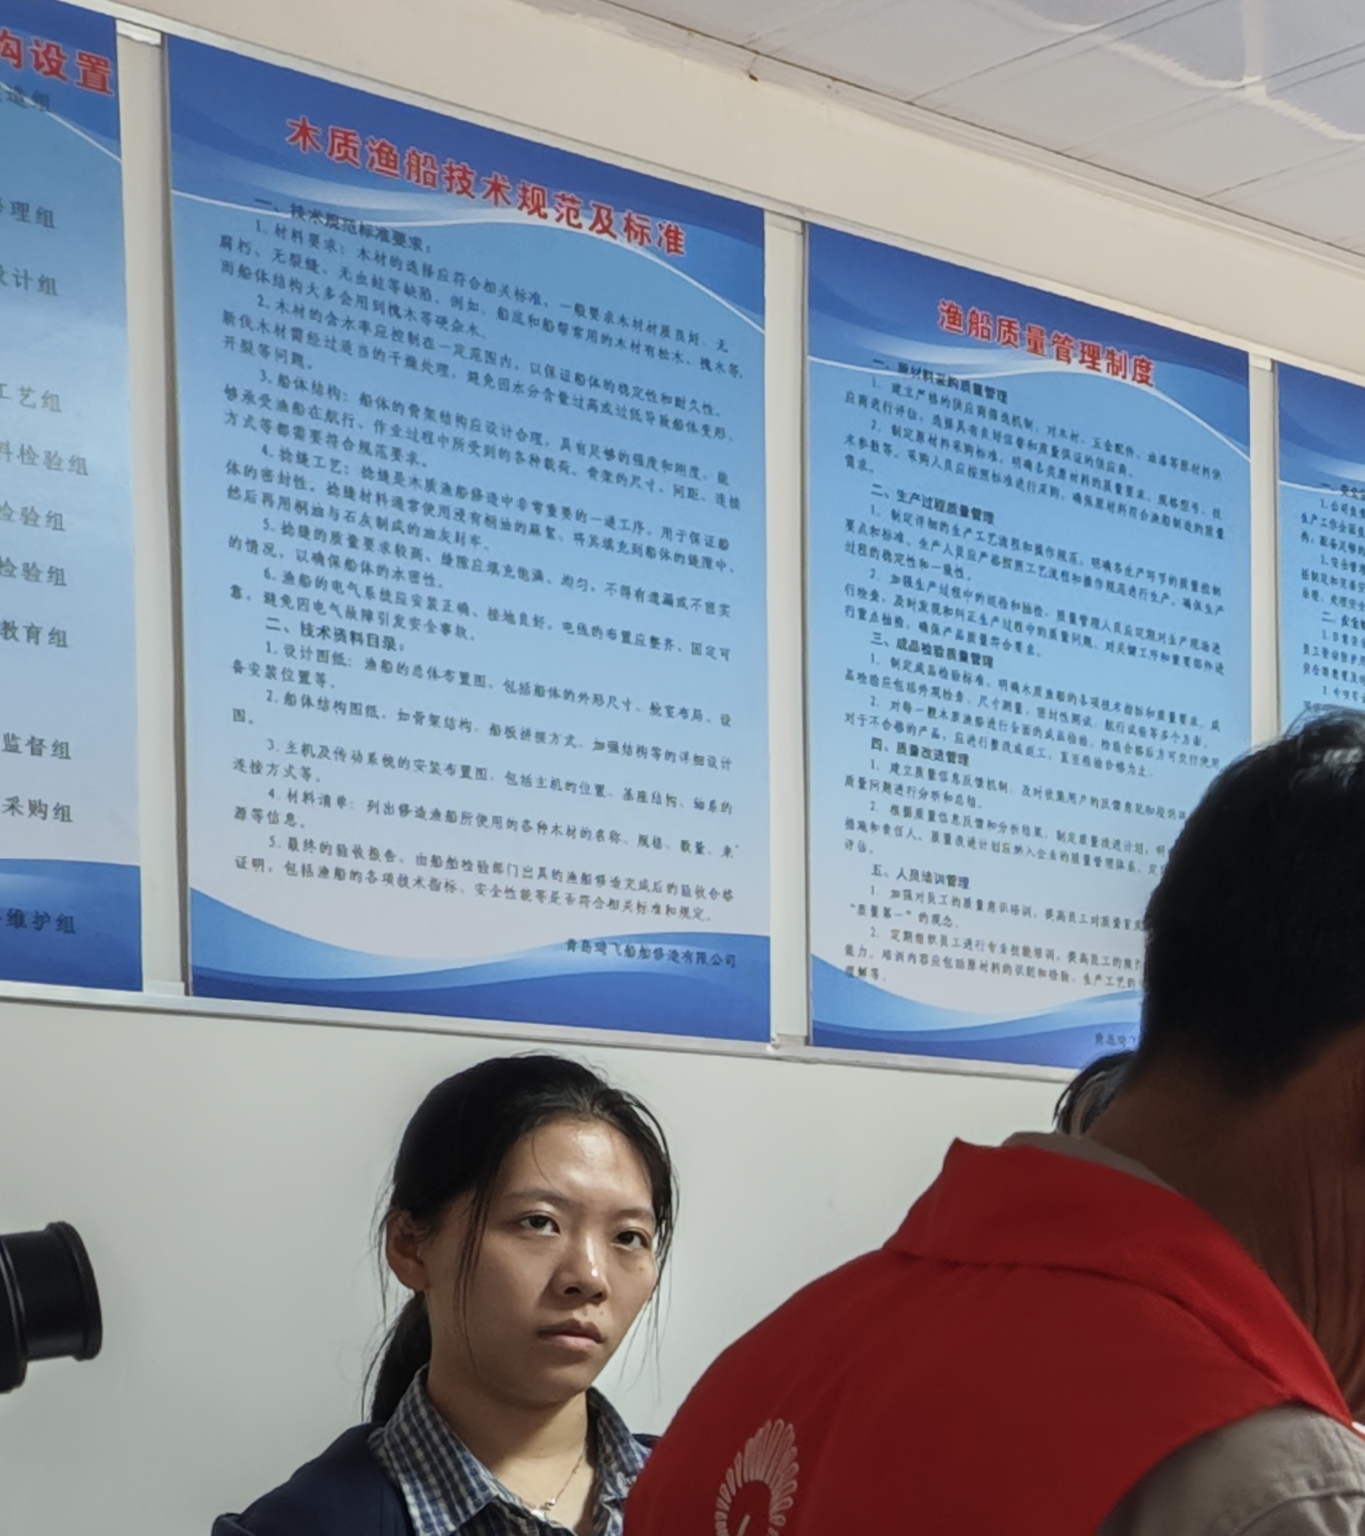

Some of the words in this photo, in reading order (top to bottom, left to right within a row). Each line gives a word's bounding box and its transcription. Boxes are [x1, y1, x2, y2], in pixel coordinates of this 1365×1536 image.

[284, 110, 685, 260] 木质渔船技术规范及标准
[0, 197, 56, 229] 理组
[936, 296, 1155, 389] 渔船质量管理制度
[0, 618, 69, 648] 教育组
[3, 732, 72, 760] 监督组
[1, 795, 73, 823] 采购组
[0, 906, 76, 934] 维护组
